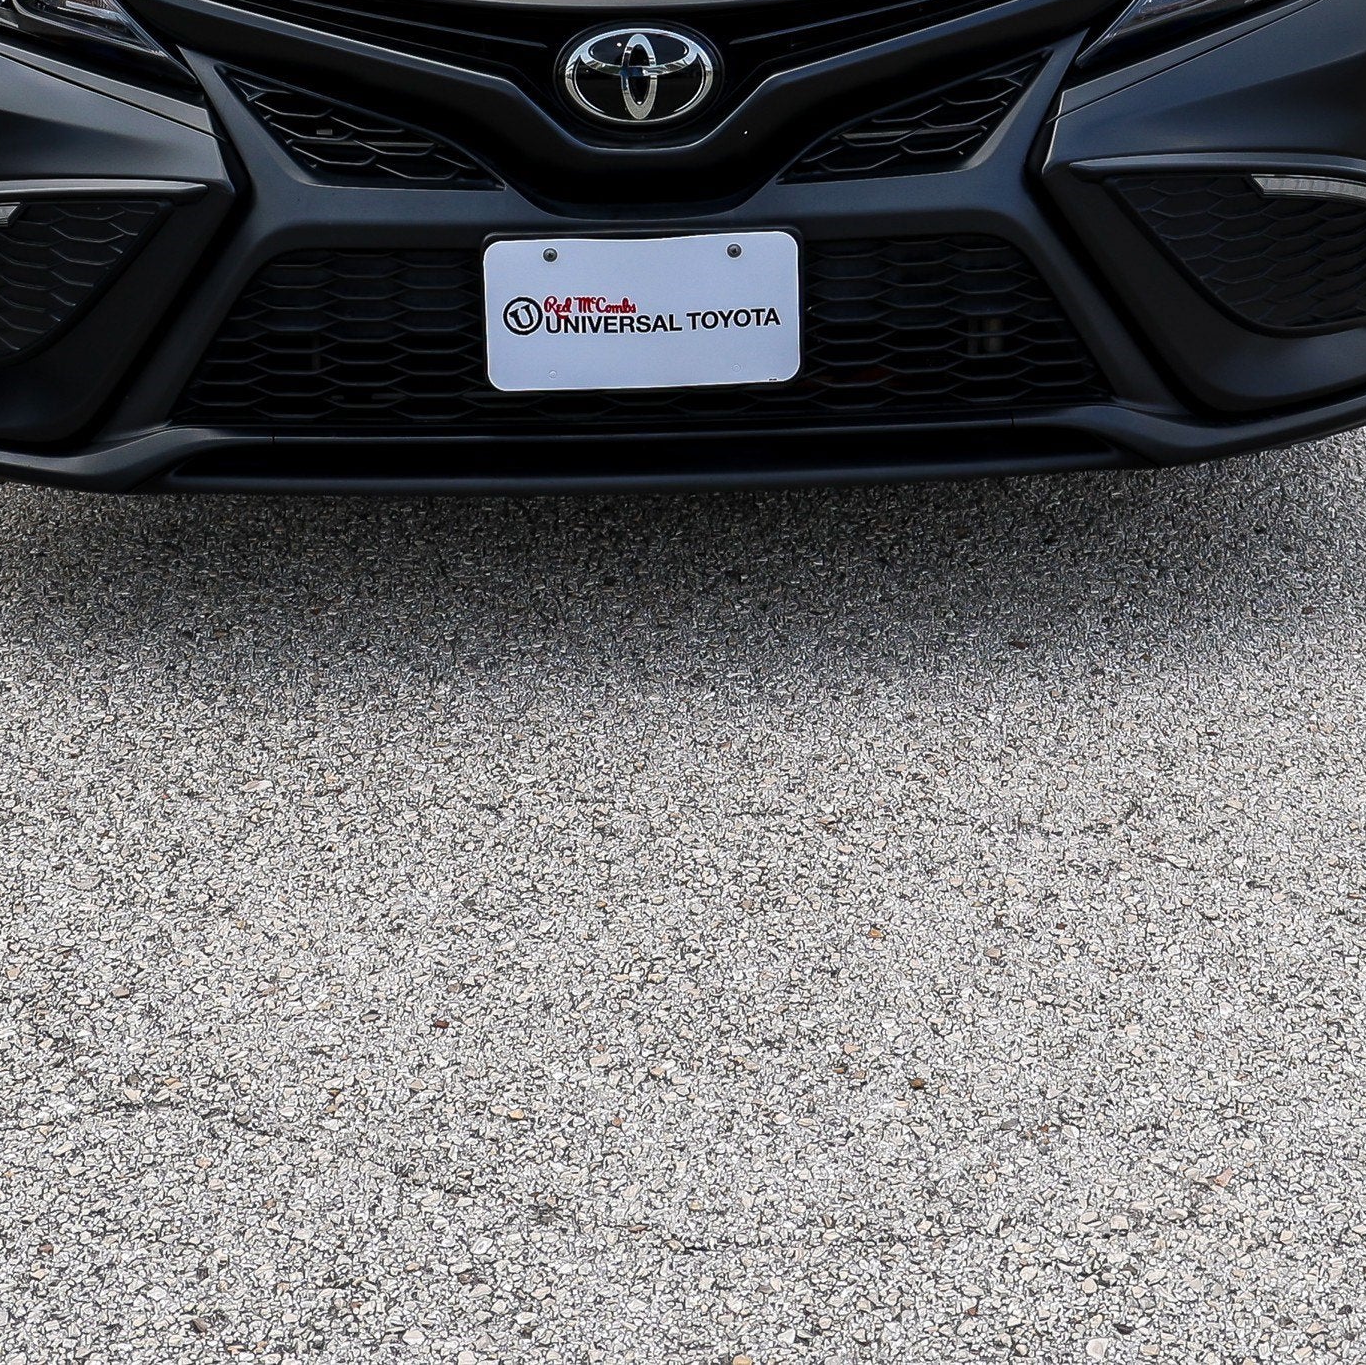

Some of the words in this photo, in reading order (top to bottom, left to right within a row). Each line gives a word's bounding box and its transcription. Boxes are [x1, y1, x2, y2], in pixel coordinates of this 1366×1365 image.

[543, 296, 572, 319] Red
[573, 296, 637, 314] McCombs
[545, 314, 683, 334] UNIVERSAL
[686, 307, 781, 330] TOYOTA
